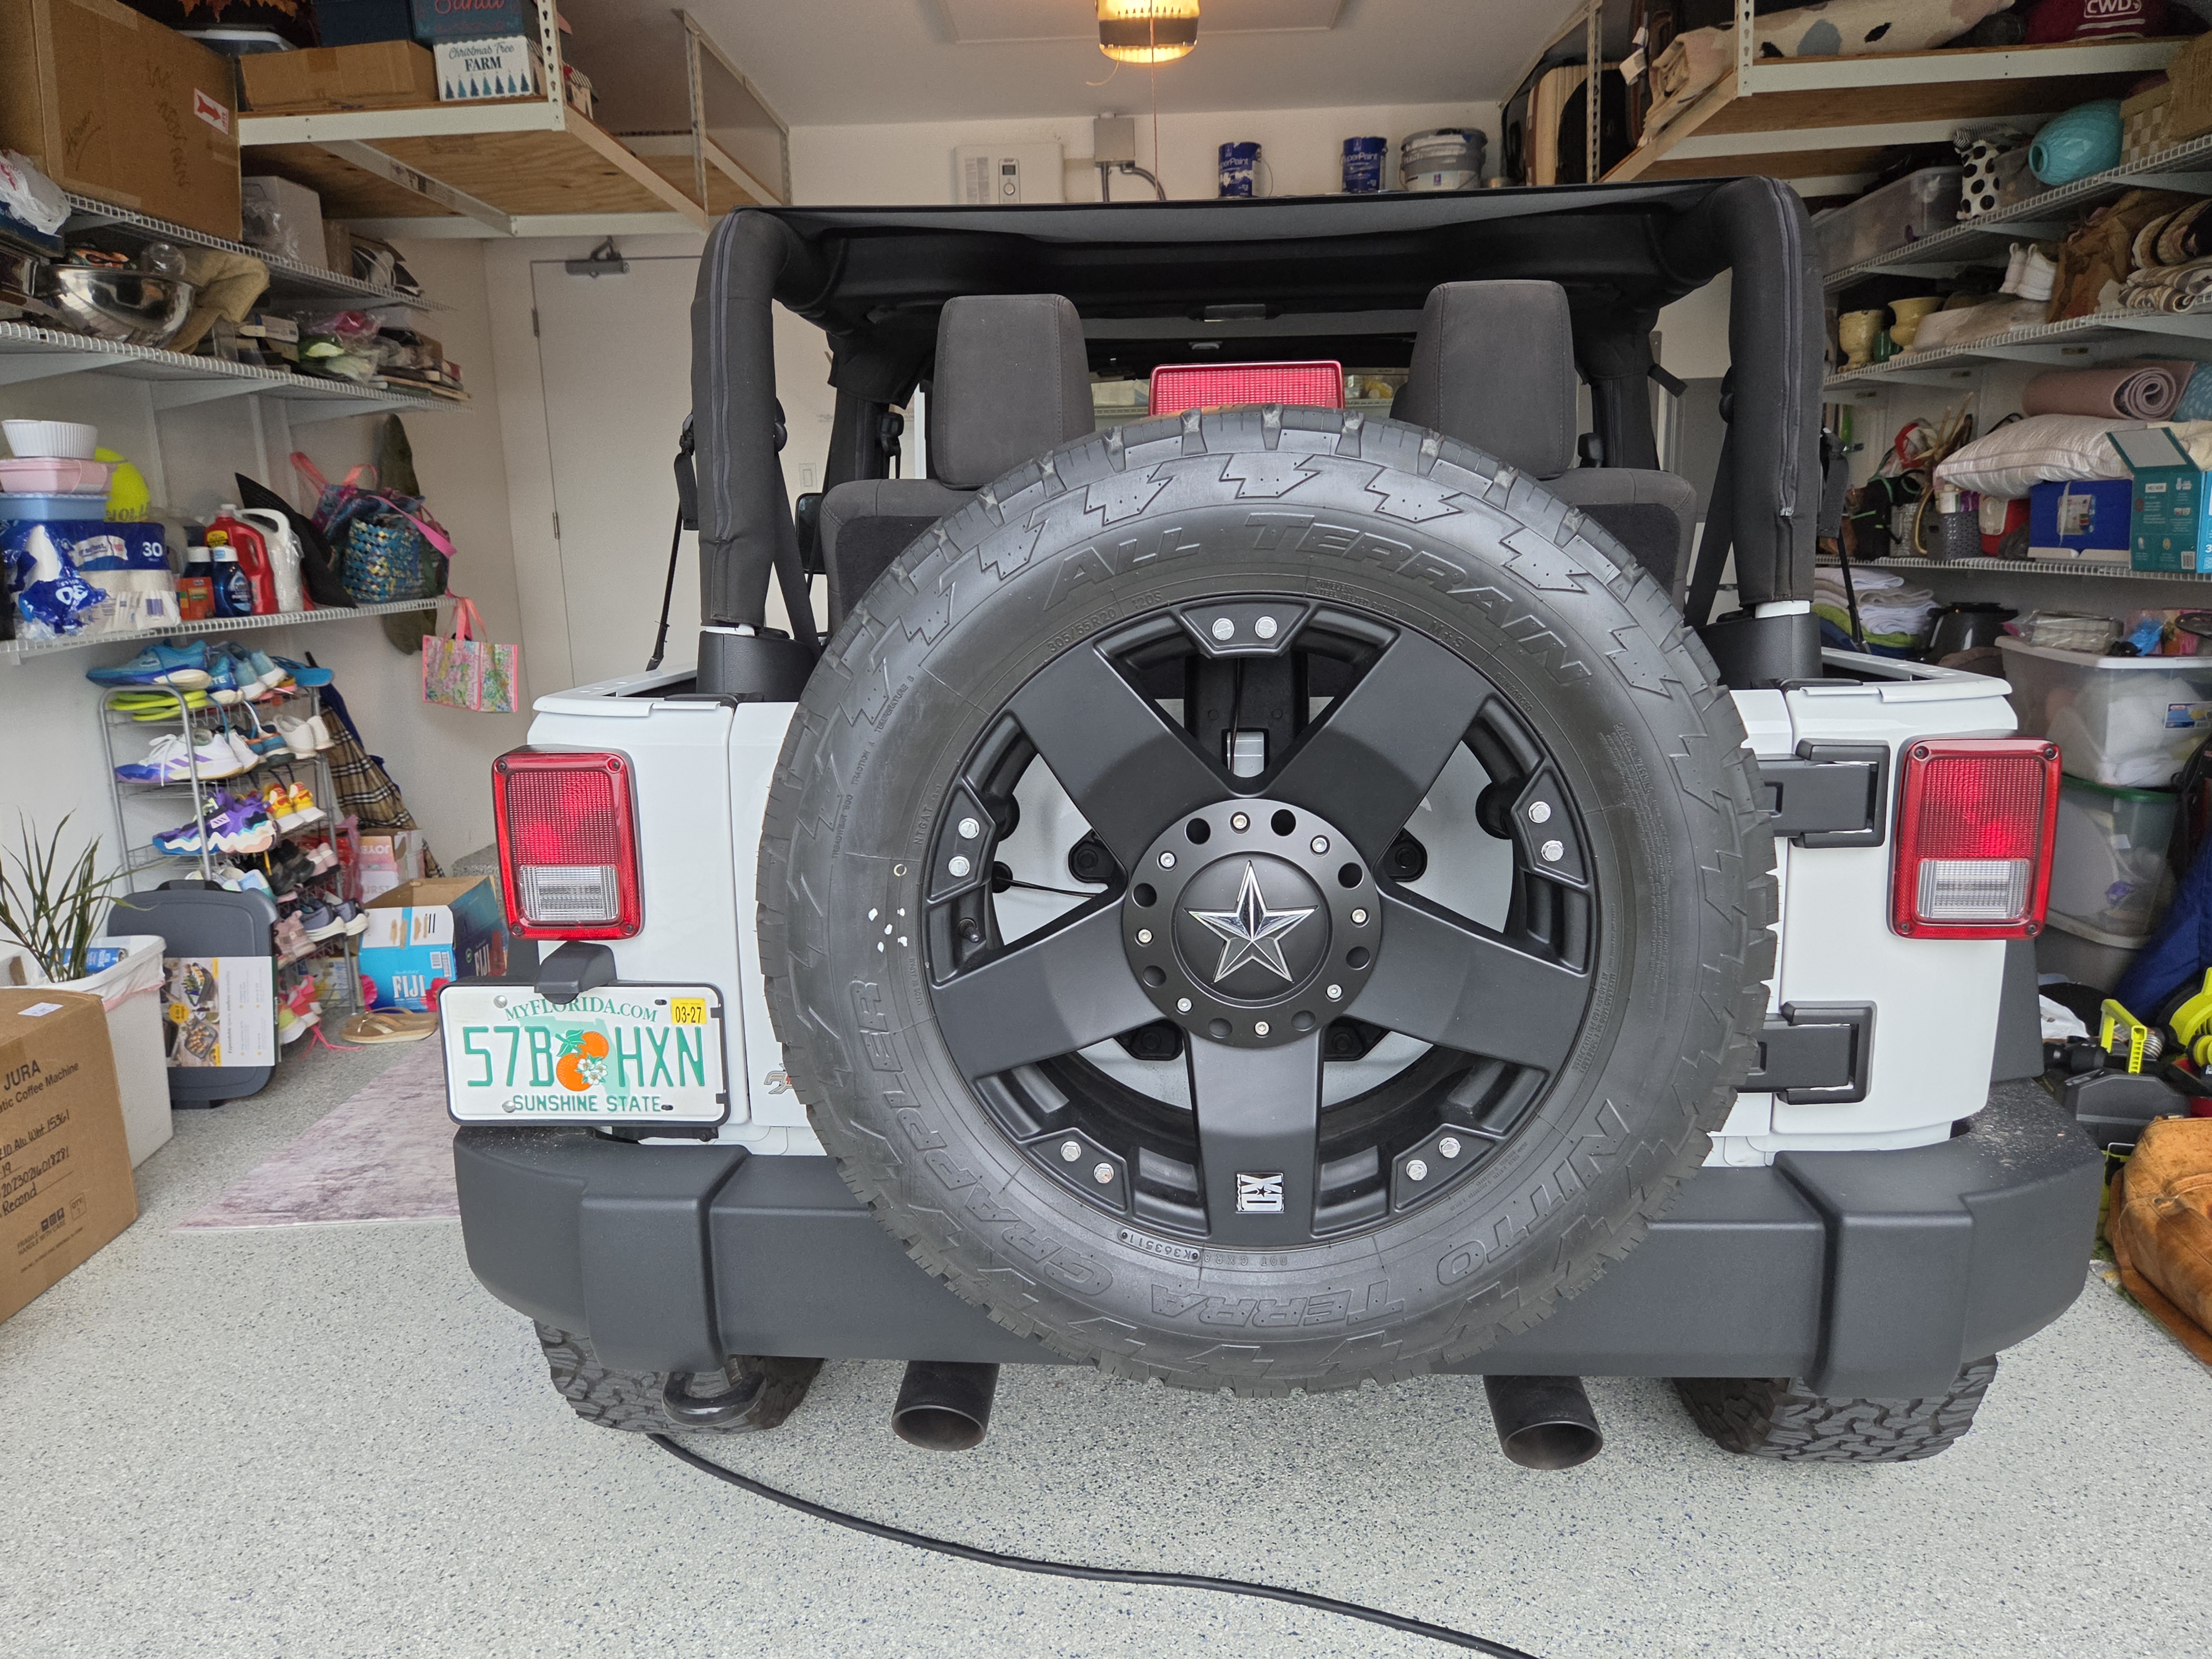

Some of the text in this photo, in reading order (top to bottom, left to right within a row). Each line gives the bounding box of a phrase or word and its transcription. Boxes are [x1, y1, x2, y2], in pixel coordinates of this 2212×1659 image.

[448, 41, 515, 59] Christmas Tree
[465, 56, 502, 72] FARM
[1220, 158, 1249, 168] perPaint
[143, 541, 163, 557] 30
[1044, 527, 1200, 612] ALL
[1244, 513, 1593, 685] TERRAIN
[1045, 604, 1118, 656] 305/55R20
[1493, 671, 1533, 713] REINFORCED
[1613, 721, 1635, 755] SAFETY
[851, 749, 871, 786] TRACTION
[913, 805, 935, 845] NTGAT
[474, 943, 491, 977] FIJI
[392, 974, 426, 998] FIJI
[504, 997, 658, 1022] MYFLORIDA.COM
[675, 1006, 702, 1023] 03-27
[463, 1026, 705, 1087] 57B HXN
[4, 1060, 41, 1091] JURA
[15, 1082, 44, 1103] Coffee
[45, 1063, 79, 1087] Machine
[513, 1094, 661, 1113] SUNSHINE STATE
[849, 979, 1112, 1296] GRAPPLER
[1436, 1098, 1632, 1287] NITTO
[1128, 1232, 1191, 1261] K363511
[1151, 1279, 1405, 1329] TERRA
